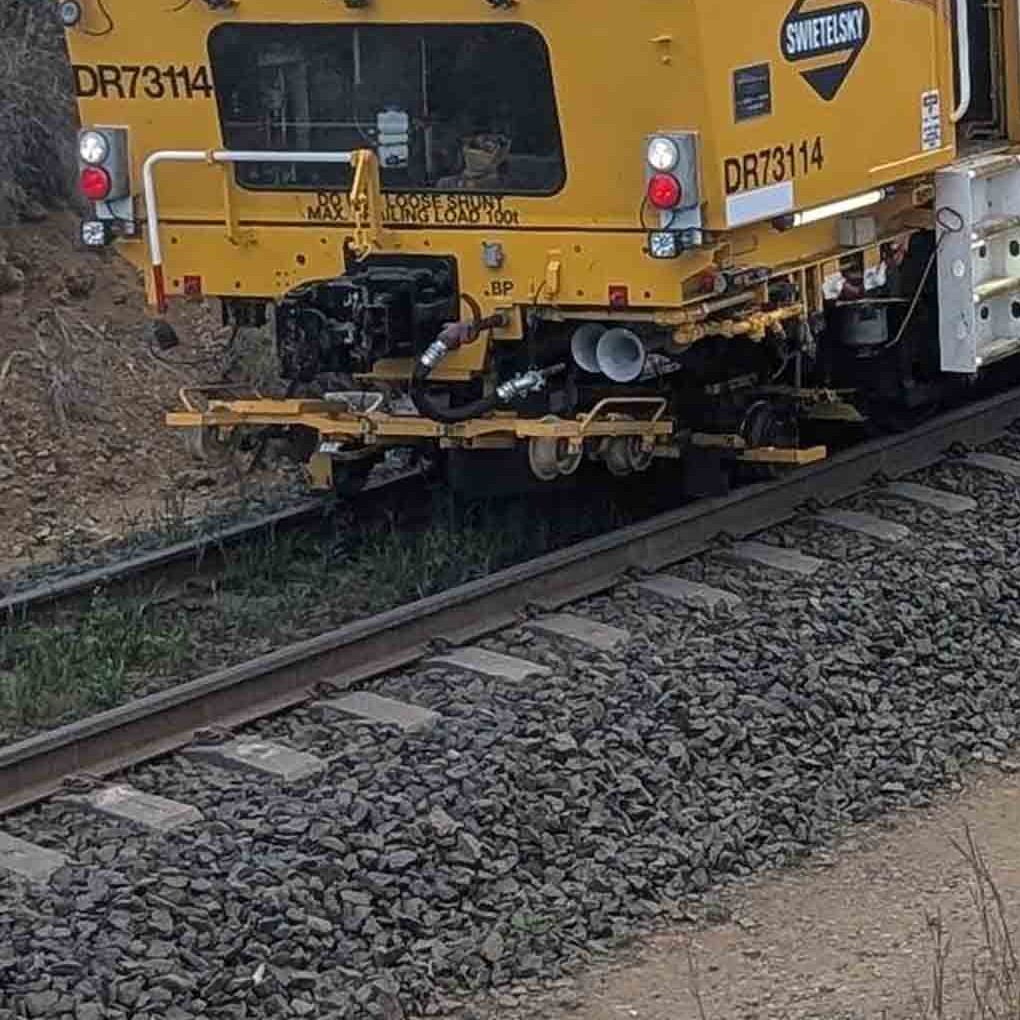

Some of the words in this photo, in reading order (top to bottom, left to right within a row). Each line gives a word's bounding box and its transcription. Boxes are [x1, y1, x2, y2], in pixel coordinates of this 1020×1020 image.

[785, 8, 864, 54] SWIETELSKY
[72, 64, 214, 99] DR73114
[724, 136, 824, 195] DR73114
[318, 192, 341, 207] DO
[386, 192, 443, 210] LOOSE
[434, 209, 480, 223] LOAD
